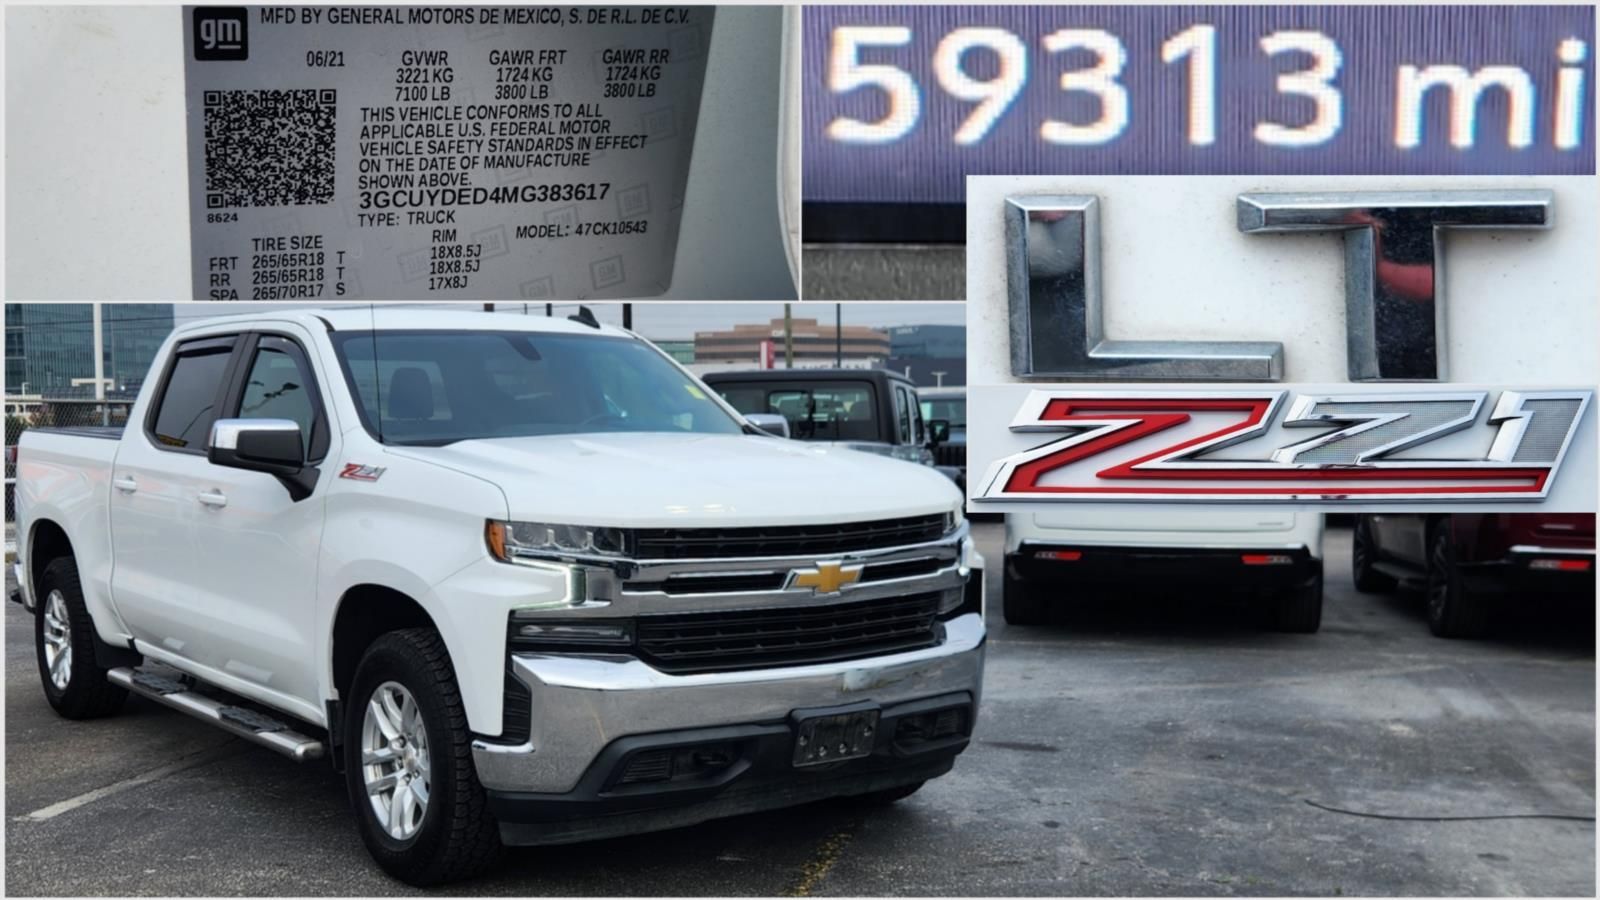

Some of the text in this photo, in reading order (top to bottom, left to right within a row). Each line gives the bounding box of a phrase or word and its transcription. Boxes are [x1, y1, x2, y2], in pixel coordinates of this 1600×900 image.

[260, 8, 690, 27] MFD BY GENERAL MOTORS DE MEXICO, S. DE R.L. DE C.V.
[200, 18, 242, 49] gm
[306, 50, 345, 67] 06/21
[402, 50, 448, 66] GVWR
[489, 49, 567, 66] GAWR FRT
[602, 49, 670, 64] GAWR RR
[395, 67, 454, 84] 3221 KG
[496, 66, 553, 83] 1724 KG
[606, 65, 661, 81] 1724 KG
[395, 85, 451, 102] 7100 LB
[495, 84, 549, 100] 3800 LB
[603, 82, 656, 99] 3800 LB
[825, 24, 1587, 150] 59313 mi
[360, 103, 603, 122] THIS VEHICLE CONFORMS TO ALL
[360, 119, 611, 140] APPLICABLE U.S. FEDERAL MOTOR
[359, 134, 648, 157] VEHICLE SAFETY STANDARDS IN EFFECT
[359, 152, 591, 173] ON THE DATE OF MANUFACTURE
[358, 173, 472, 190] SHOWN ABOVE.
[359, 183, 610, 210] 3GCUYDED4MG383617
[207, 213, 239, 223] 8624
[358, 209, 456, 227] TYPE: TRUCK
[432, 229, 457, 243] RIM
[516, 220, 648, 240] MODEL: 47CK10543
[252, 235, 323, 252] TIRE SIZE
[209, 244, 482, 271] FRT 265/65R18 T 18X8.5J
[210, 273, 231, 287] RR
[252, 267, 324, 285] 265/65R18
[336, 267, 346, 280] T
[429, 260, 480, 275] 18X8.5J
[209, 275, 469, 300] SPA 265/70R17 S 17X8J
[1004, 188, 1556, 382] LT
[970, 388, 1595, 502] Z71
